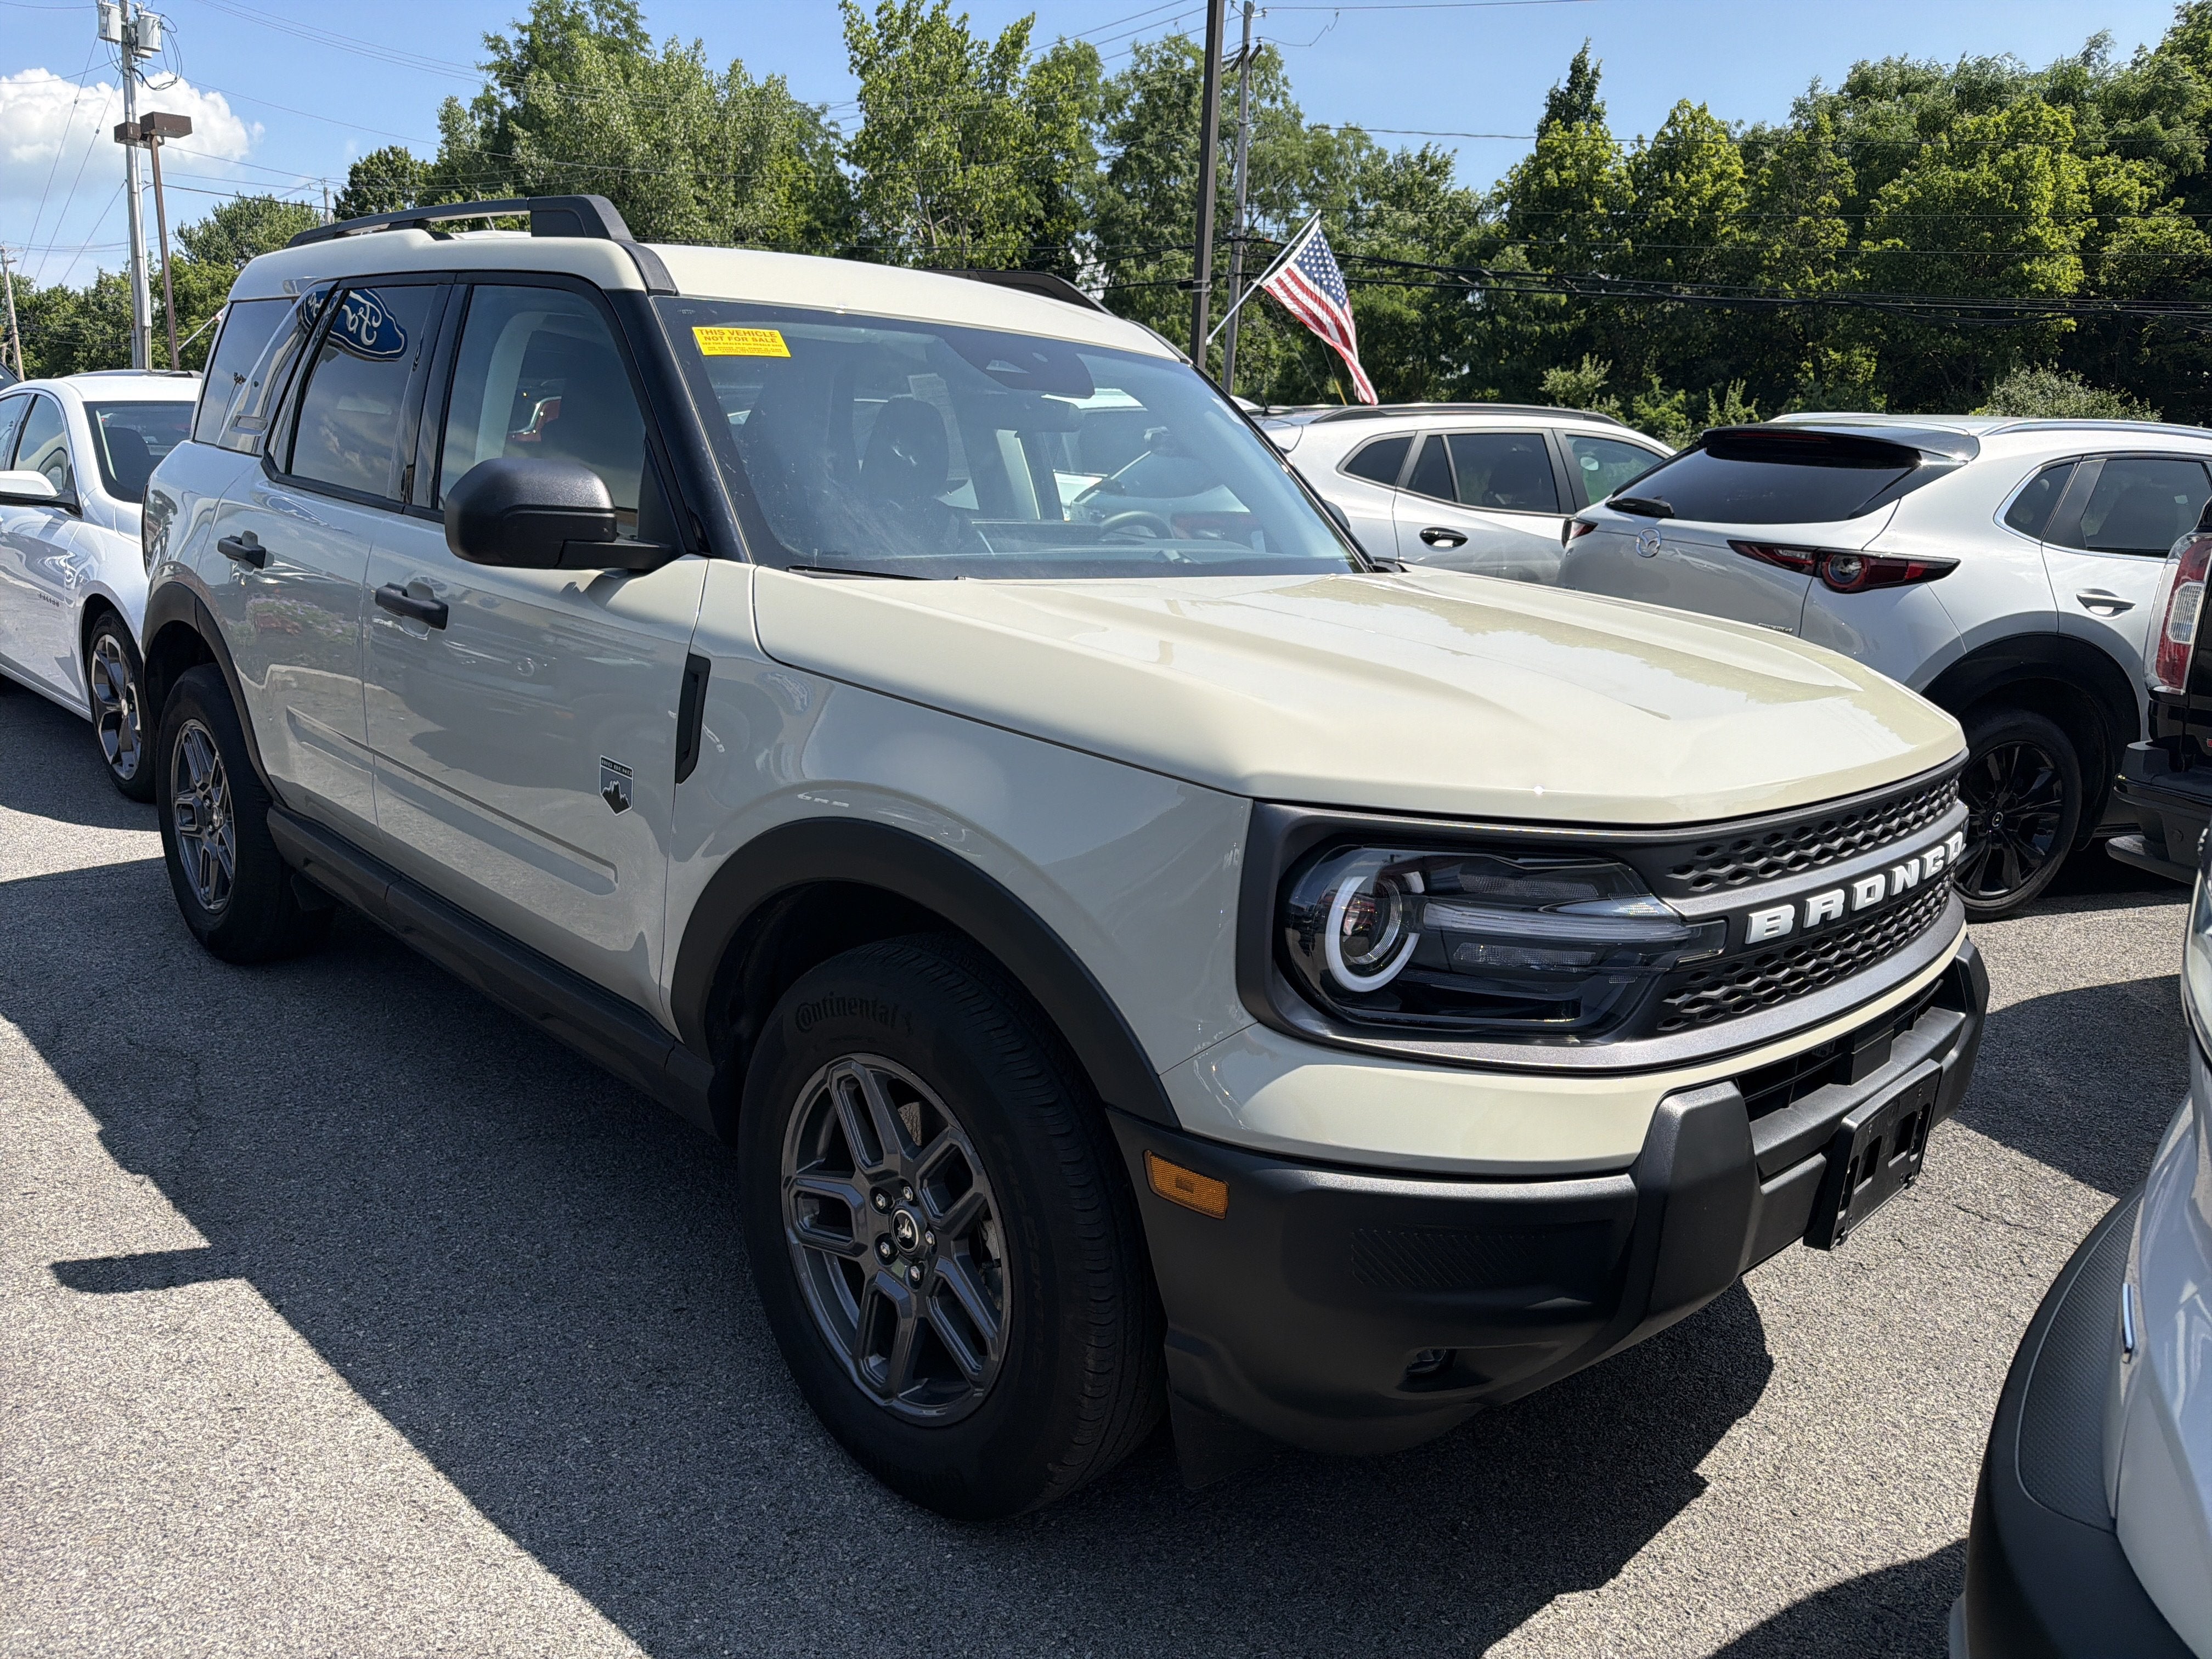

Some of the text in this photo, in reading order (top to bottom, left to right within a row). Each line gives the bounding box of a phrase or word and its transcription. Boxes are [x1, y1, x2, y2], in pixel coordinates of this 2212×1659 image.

[727, 330, 777, 338] VEHICLE
[601, 759, 632, 776] BIG BEND
[1745, 831, 1963, 944] BRONCO
[795, 991, 900, 1033] Continental
